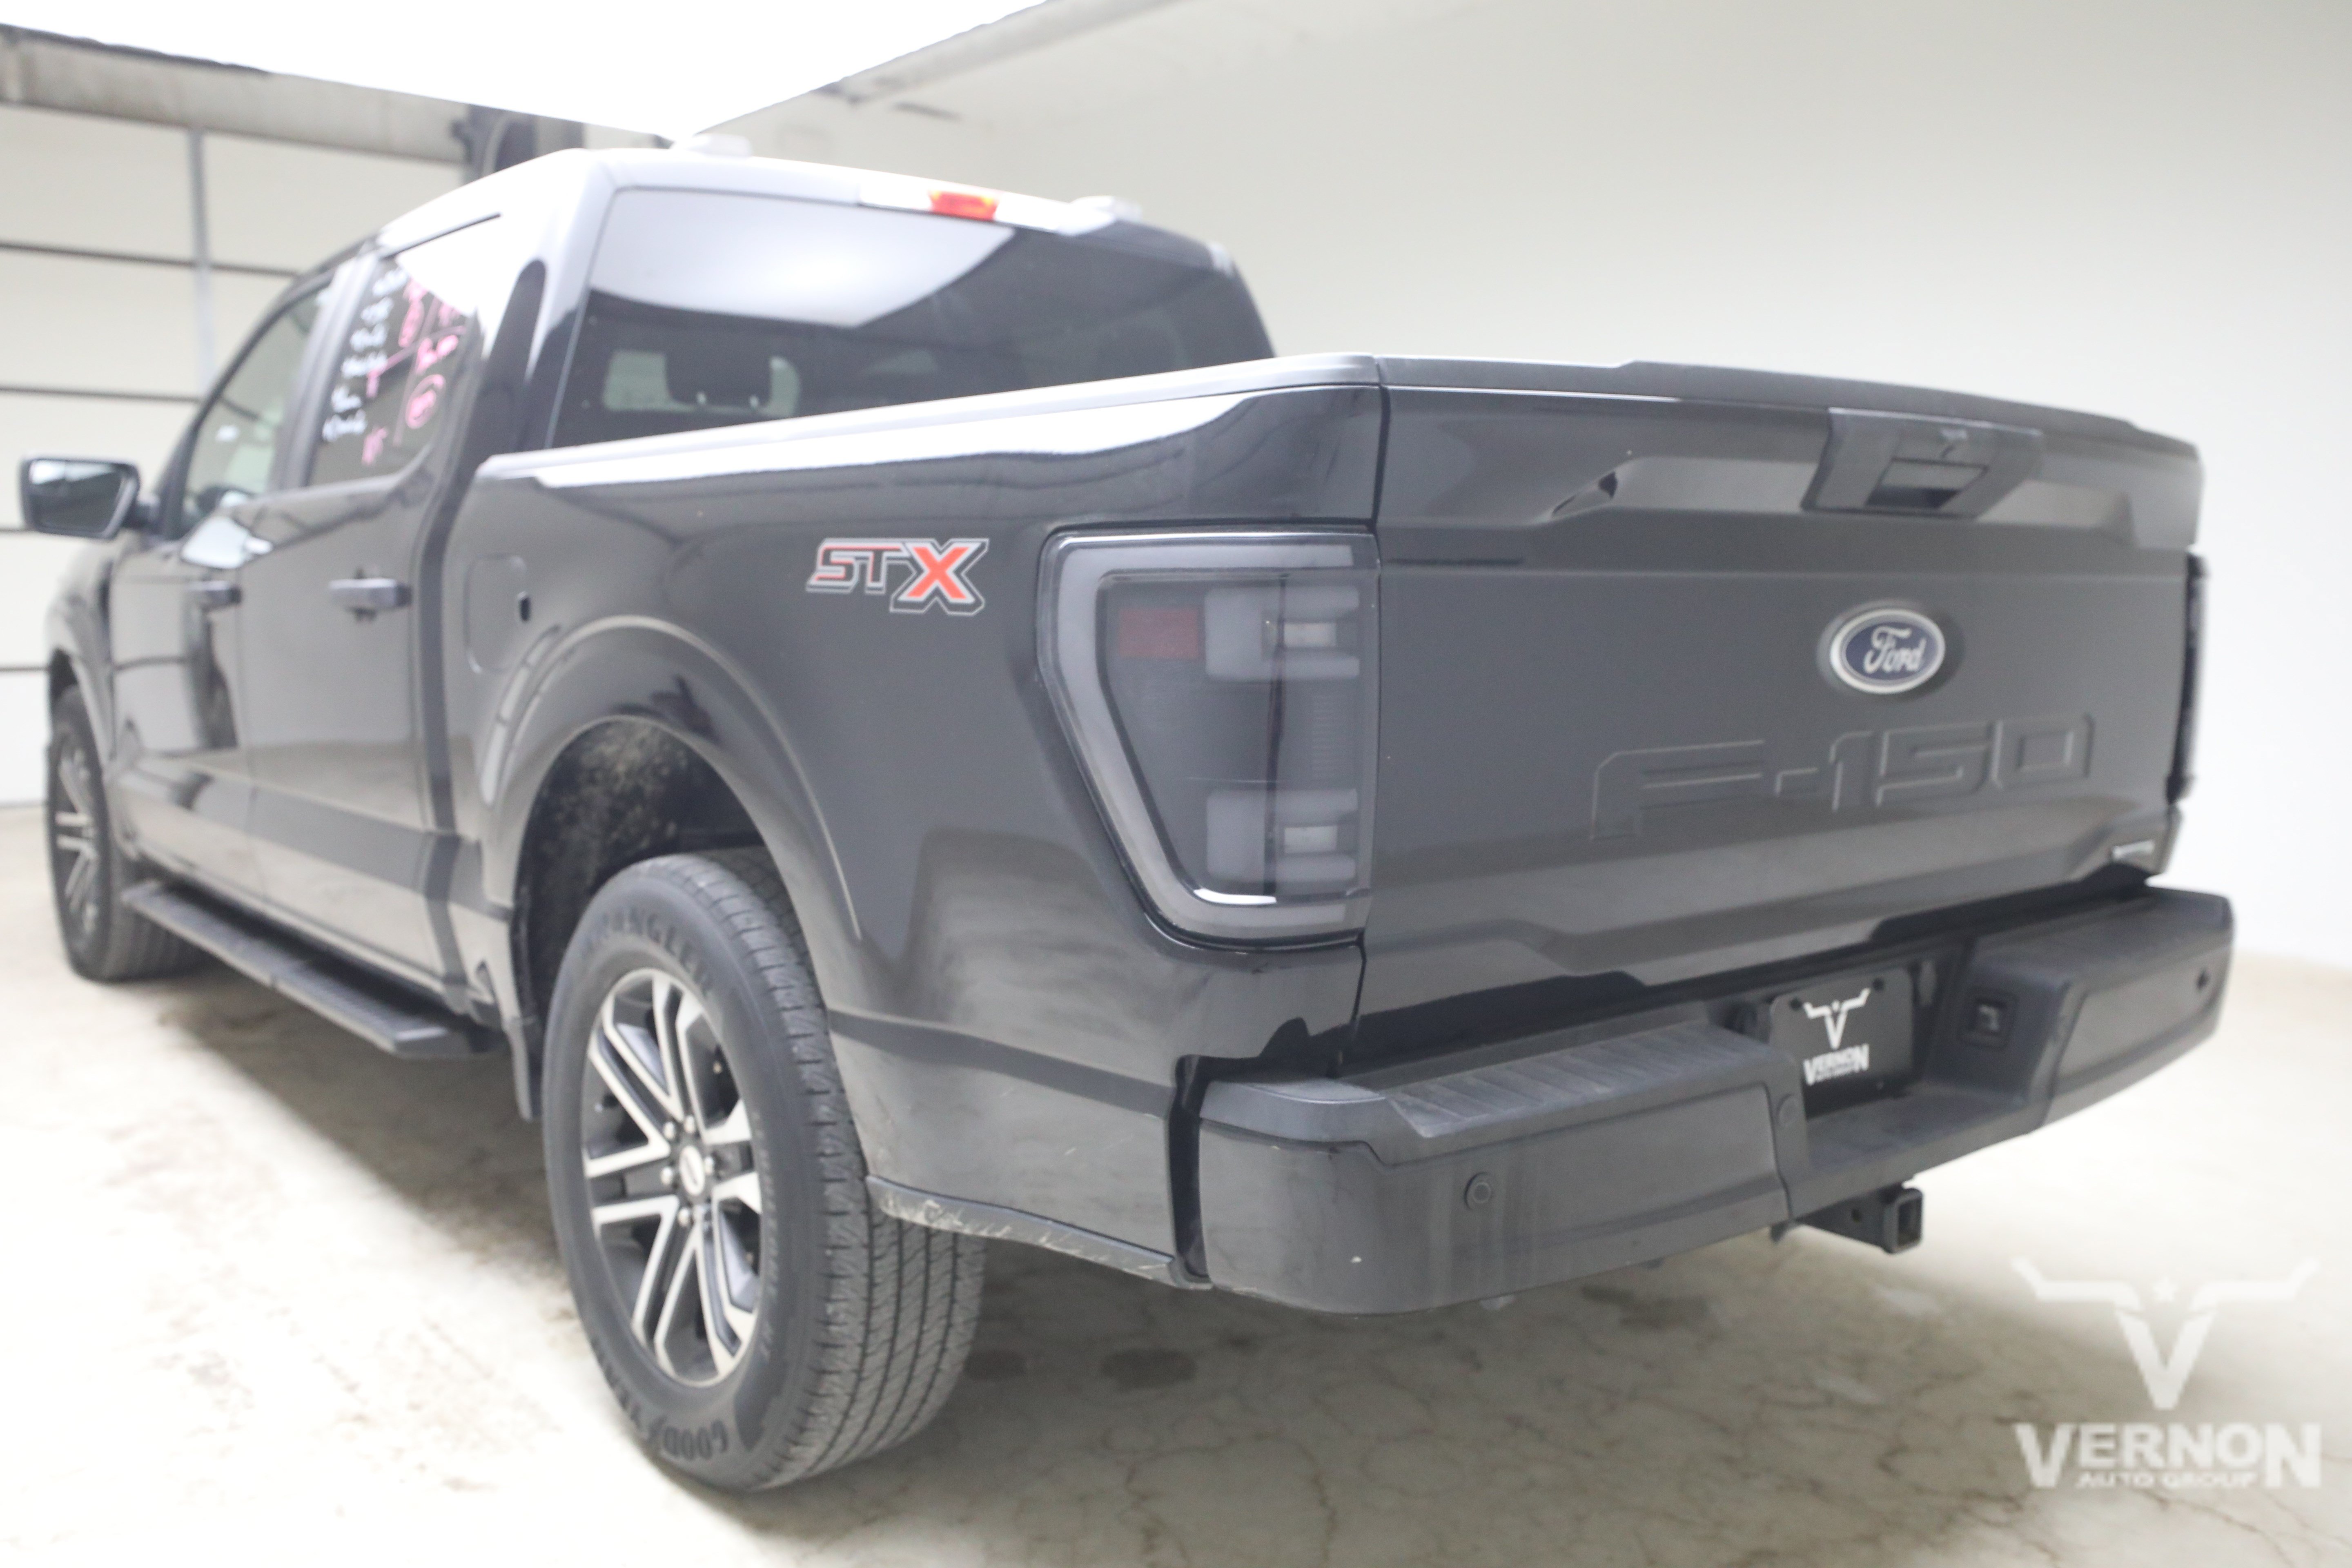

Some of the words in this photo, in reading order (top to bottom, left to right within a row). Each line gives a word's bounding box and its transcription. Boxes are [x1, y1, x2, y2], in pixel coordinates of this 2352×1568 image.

[806, 537, 989, 616] STX
[1863, 625, 1927, 674] Ford
[1590, 714, 2095, 842] F-150
